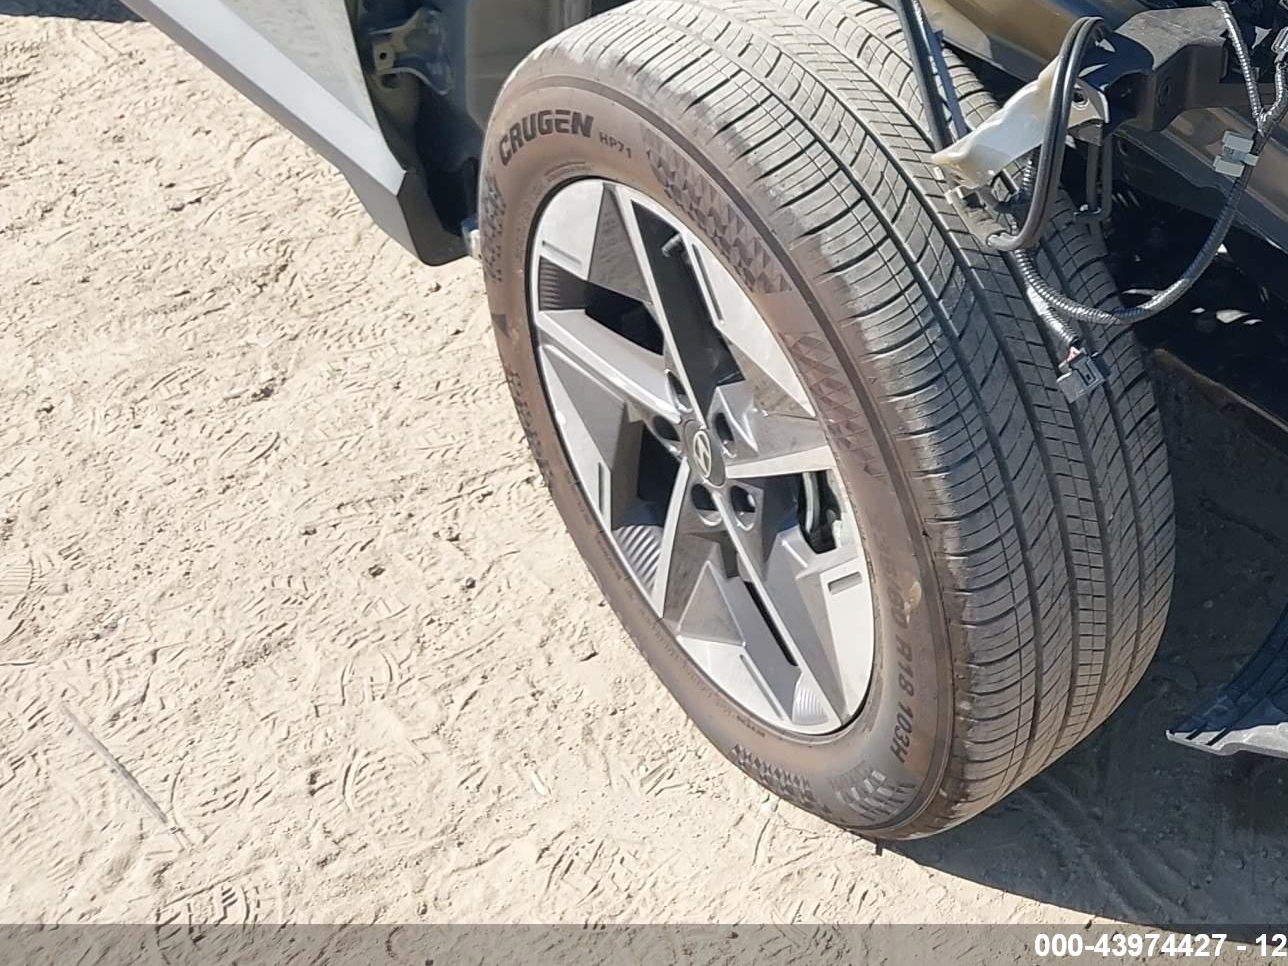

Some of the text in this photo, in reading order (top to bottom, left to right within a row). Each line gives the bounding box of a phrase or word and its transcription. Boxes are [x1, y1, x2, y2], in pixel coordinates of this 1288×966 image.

[498, 109, 633, 166] CRUGEN HP71
[896, 635, 915, 696] R18
[890, 703, 915, 763] 103H
